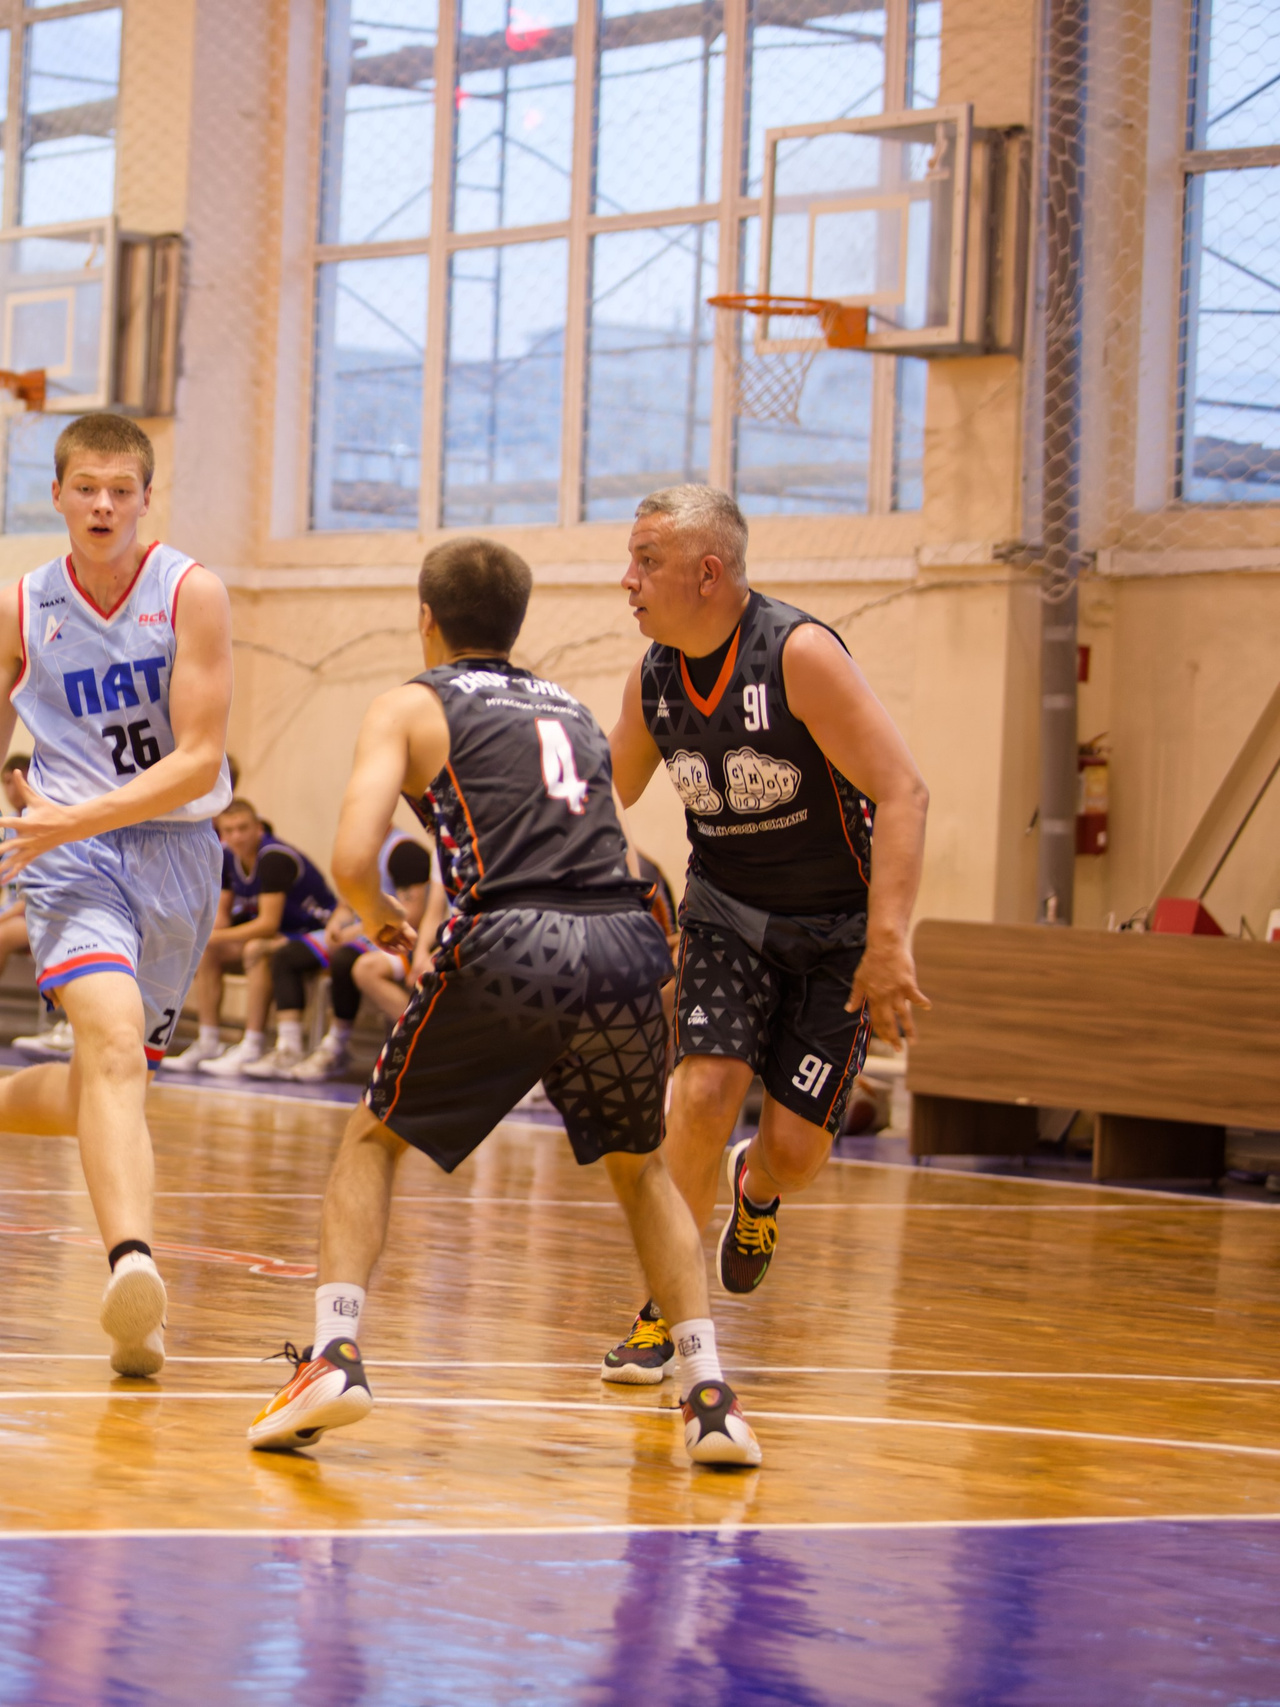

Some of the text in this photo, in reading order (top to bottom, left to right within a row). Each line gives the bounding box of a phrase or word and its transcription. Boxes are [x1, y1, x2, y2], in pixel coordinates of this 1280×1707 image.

[39, 596, 66, 609] MAXX
[63, 656, 166, 718] ПАТ
[743, 683, 769, 731] 91
[101, 719, 162, 776] 26
[534, 716, 588, 815] 4
[67, 943, 98, 955] MAXX
[792, 1054, 833, 1099] 91
